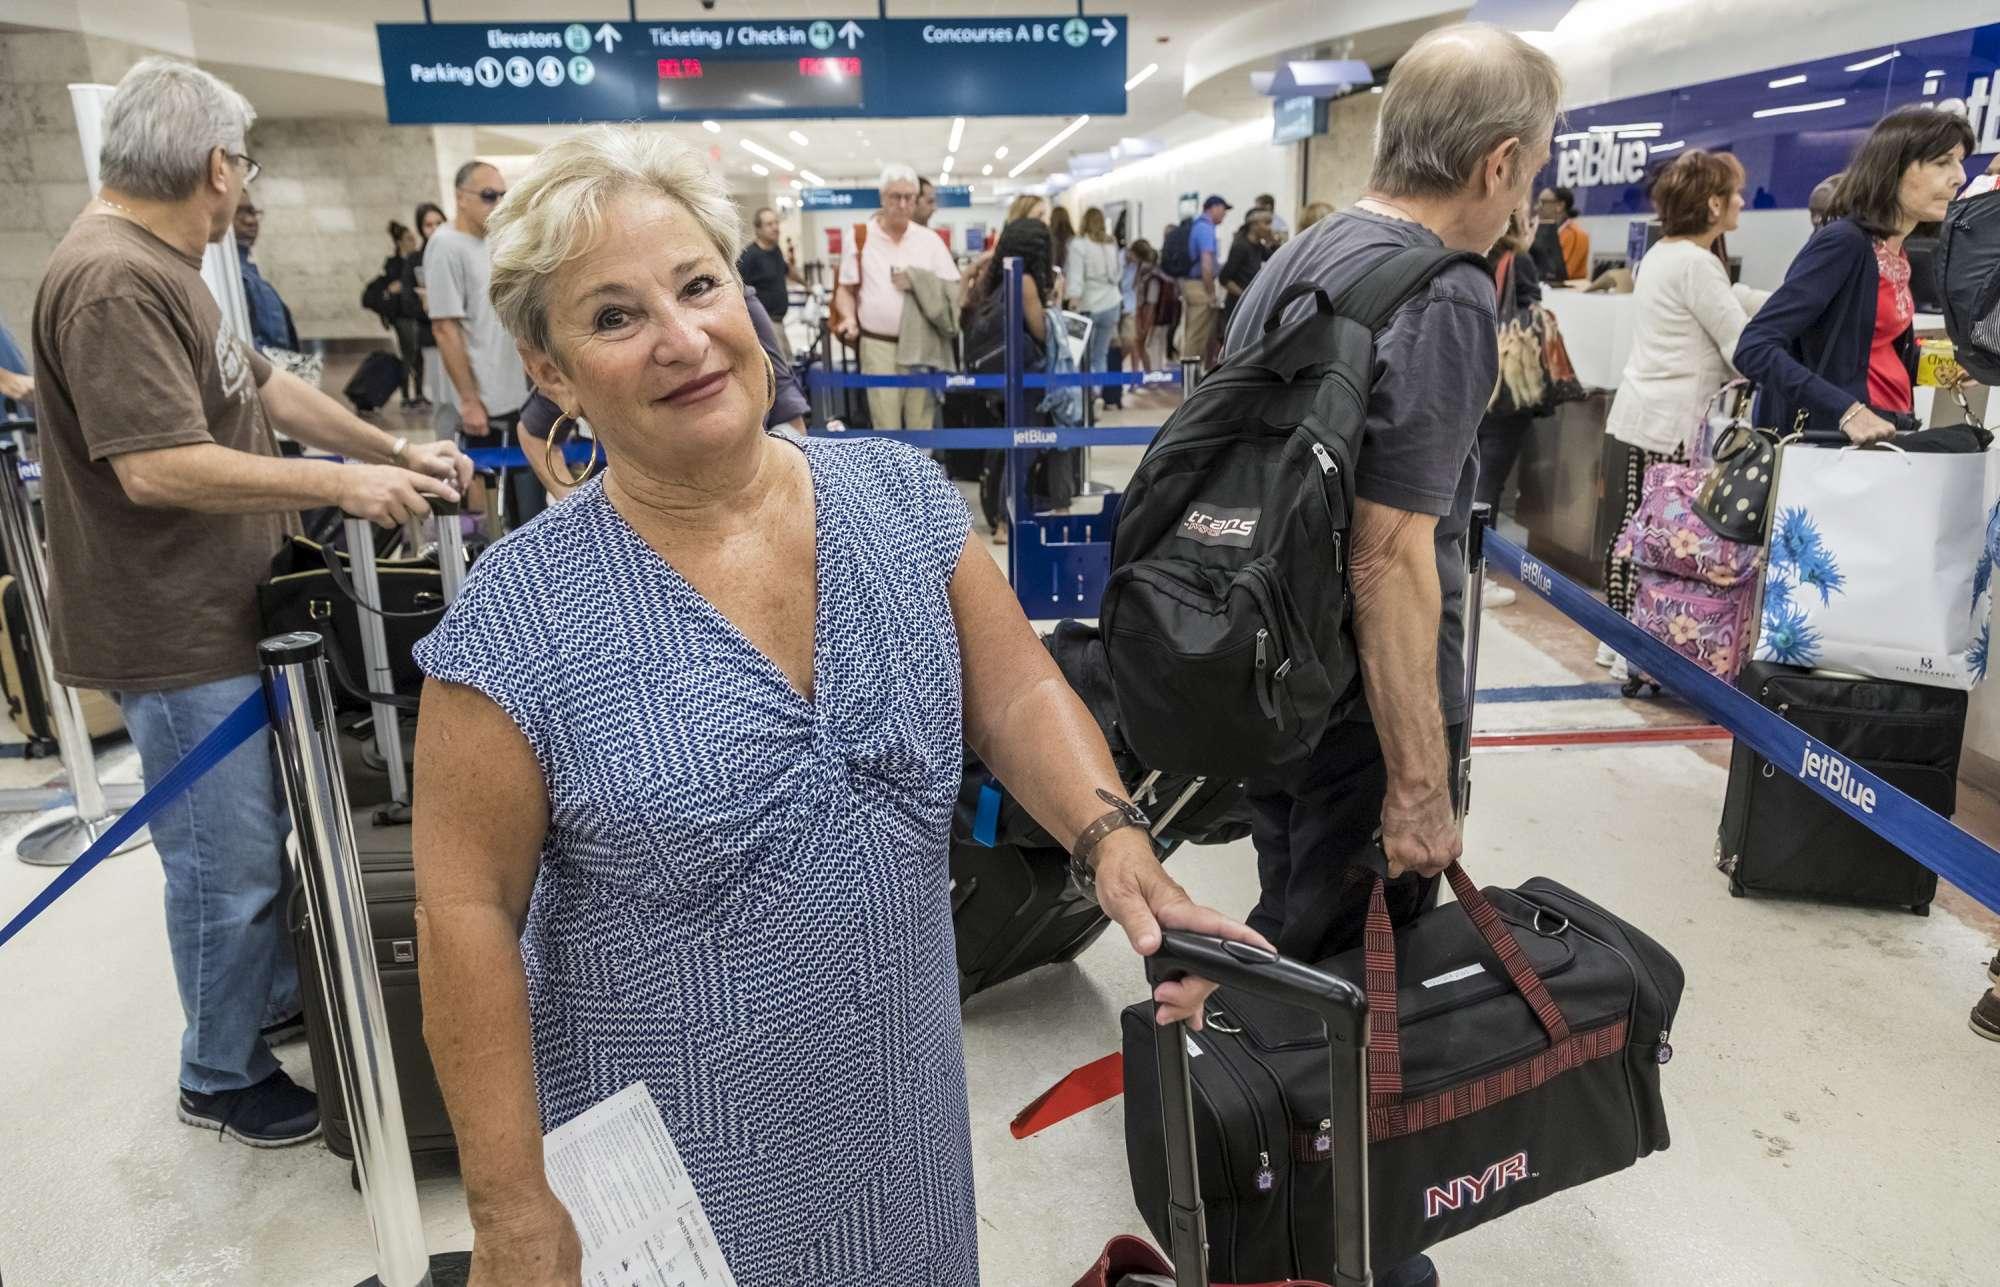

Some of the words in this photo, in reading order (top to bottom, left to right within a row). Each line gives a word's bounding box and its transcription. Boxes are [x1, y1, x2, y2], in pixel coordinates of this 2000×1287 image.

[487, 29, 562, 49] Elevators
[650, 27, 722, 49] Ticketing
[737, 26, 806, 46] Check-in
[923, 25, 1013, 43] Concourses
[1015, 24, 1030, 42] A
[1033, 24, 1044, 42] B
[1048, 24, 1060, 42] C
[410, 63, 474, 86] Parking
[1556, 132, 1648, 188] jetBlue
[945, 374, 976, 388] jetBlue
[1142, 371, 1173, 384] jetBlue
[1013, 429, 1057, 447] jetBlue
[1520, 554, 1552, 596] jetBlue
[1799, 740, 1876, 813] jetBlue
[1424, 1151, 1528, 1219] NYR
